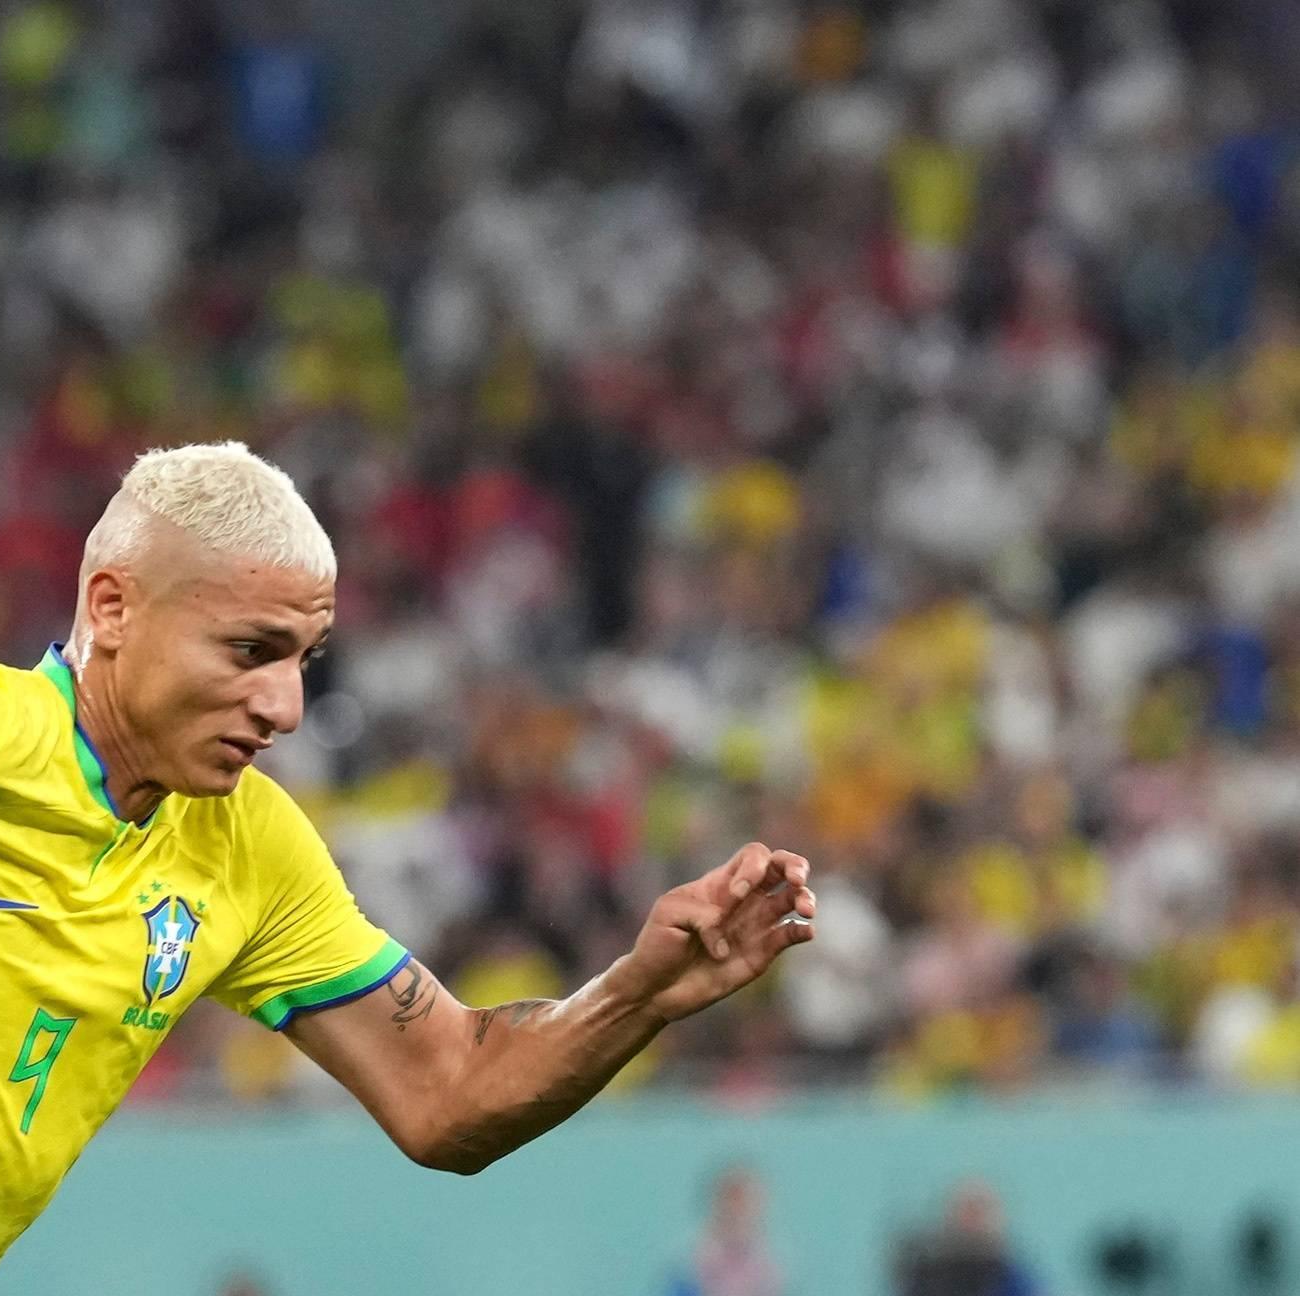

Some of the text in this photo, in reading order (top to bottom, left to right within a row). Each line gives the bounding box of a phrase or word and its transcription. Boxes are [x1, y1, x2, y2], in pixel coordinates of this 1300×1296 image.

[161, 941, 179, 955] CBF
[120, 1007, 170, 1030] BRASIL
[8, 1006, 79, 1135] 9
